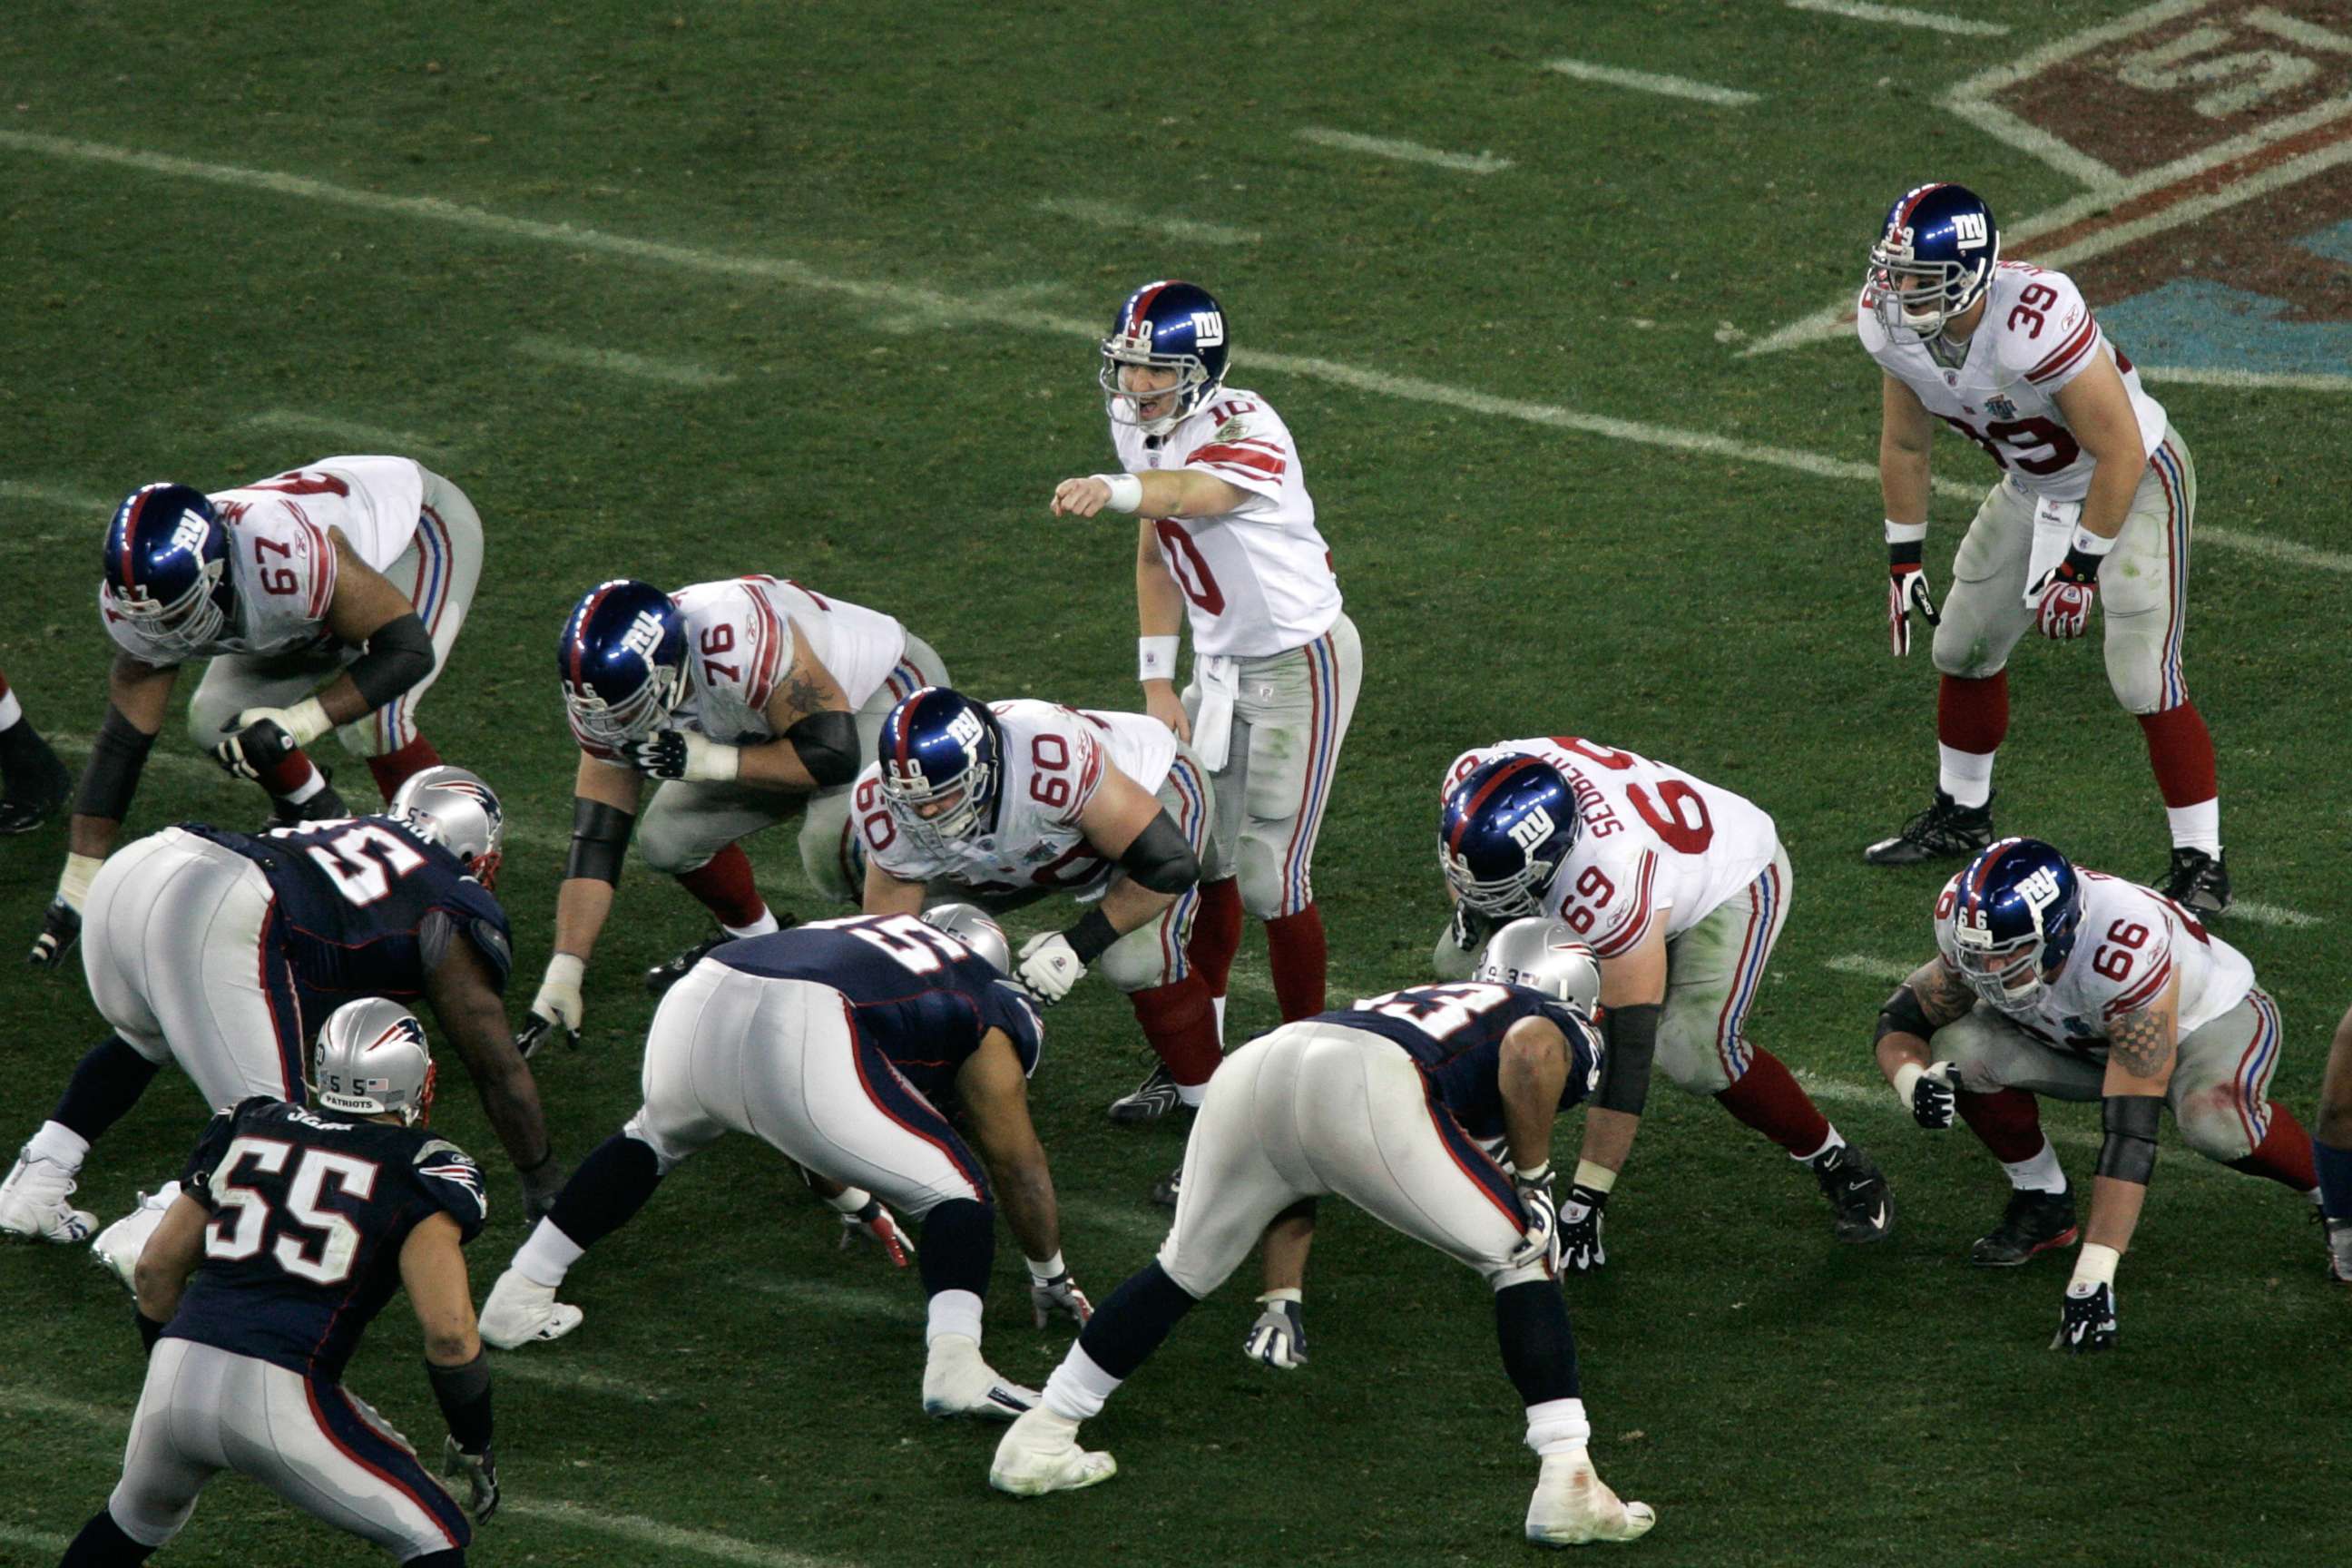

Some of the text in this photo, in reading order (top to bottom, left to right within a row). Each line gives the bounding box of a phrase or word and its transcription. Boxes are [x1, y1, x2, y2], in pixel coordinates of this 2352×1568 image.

[1885, 222, 1915, 248] 39
[2007, 282, 2058, 340] 39
[254, 536, 299, 595] 67
[701, 622, 740, 687] 76
[888, 758, 924, 779] 60
[1030, 733, 1071, 808] 60
[1559, 865, 1615, 936] 69
[1957, 906, 1988, 930] 66
[2092, 917, 2151, 983] 66
[326, 1095, 373, 1109] PATRIOTS
[329, 1074, 366, 1096] 55
[204, 1136, 378, 1285] 55
